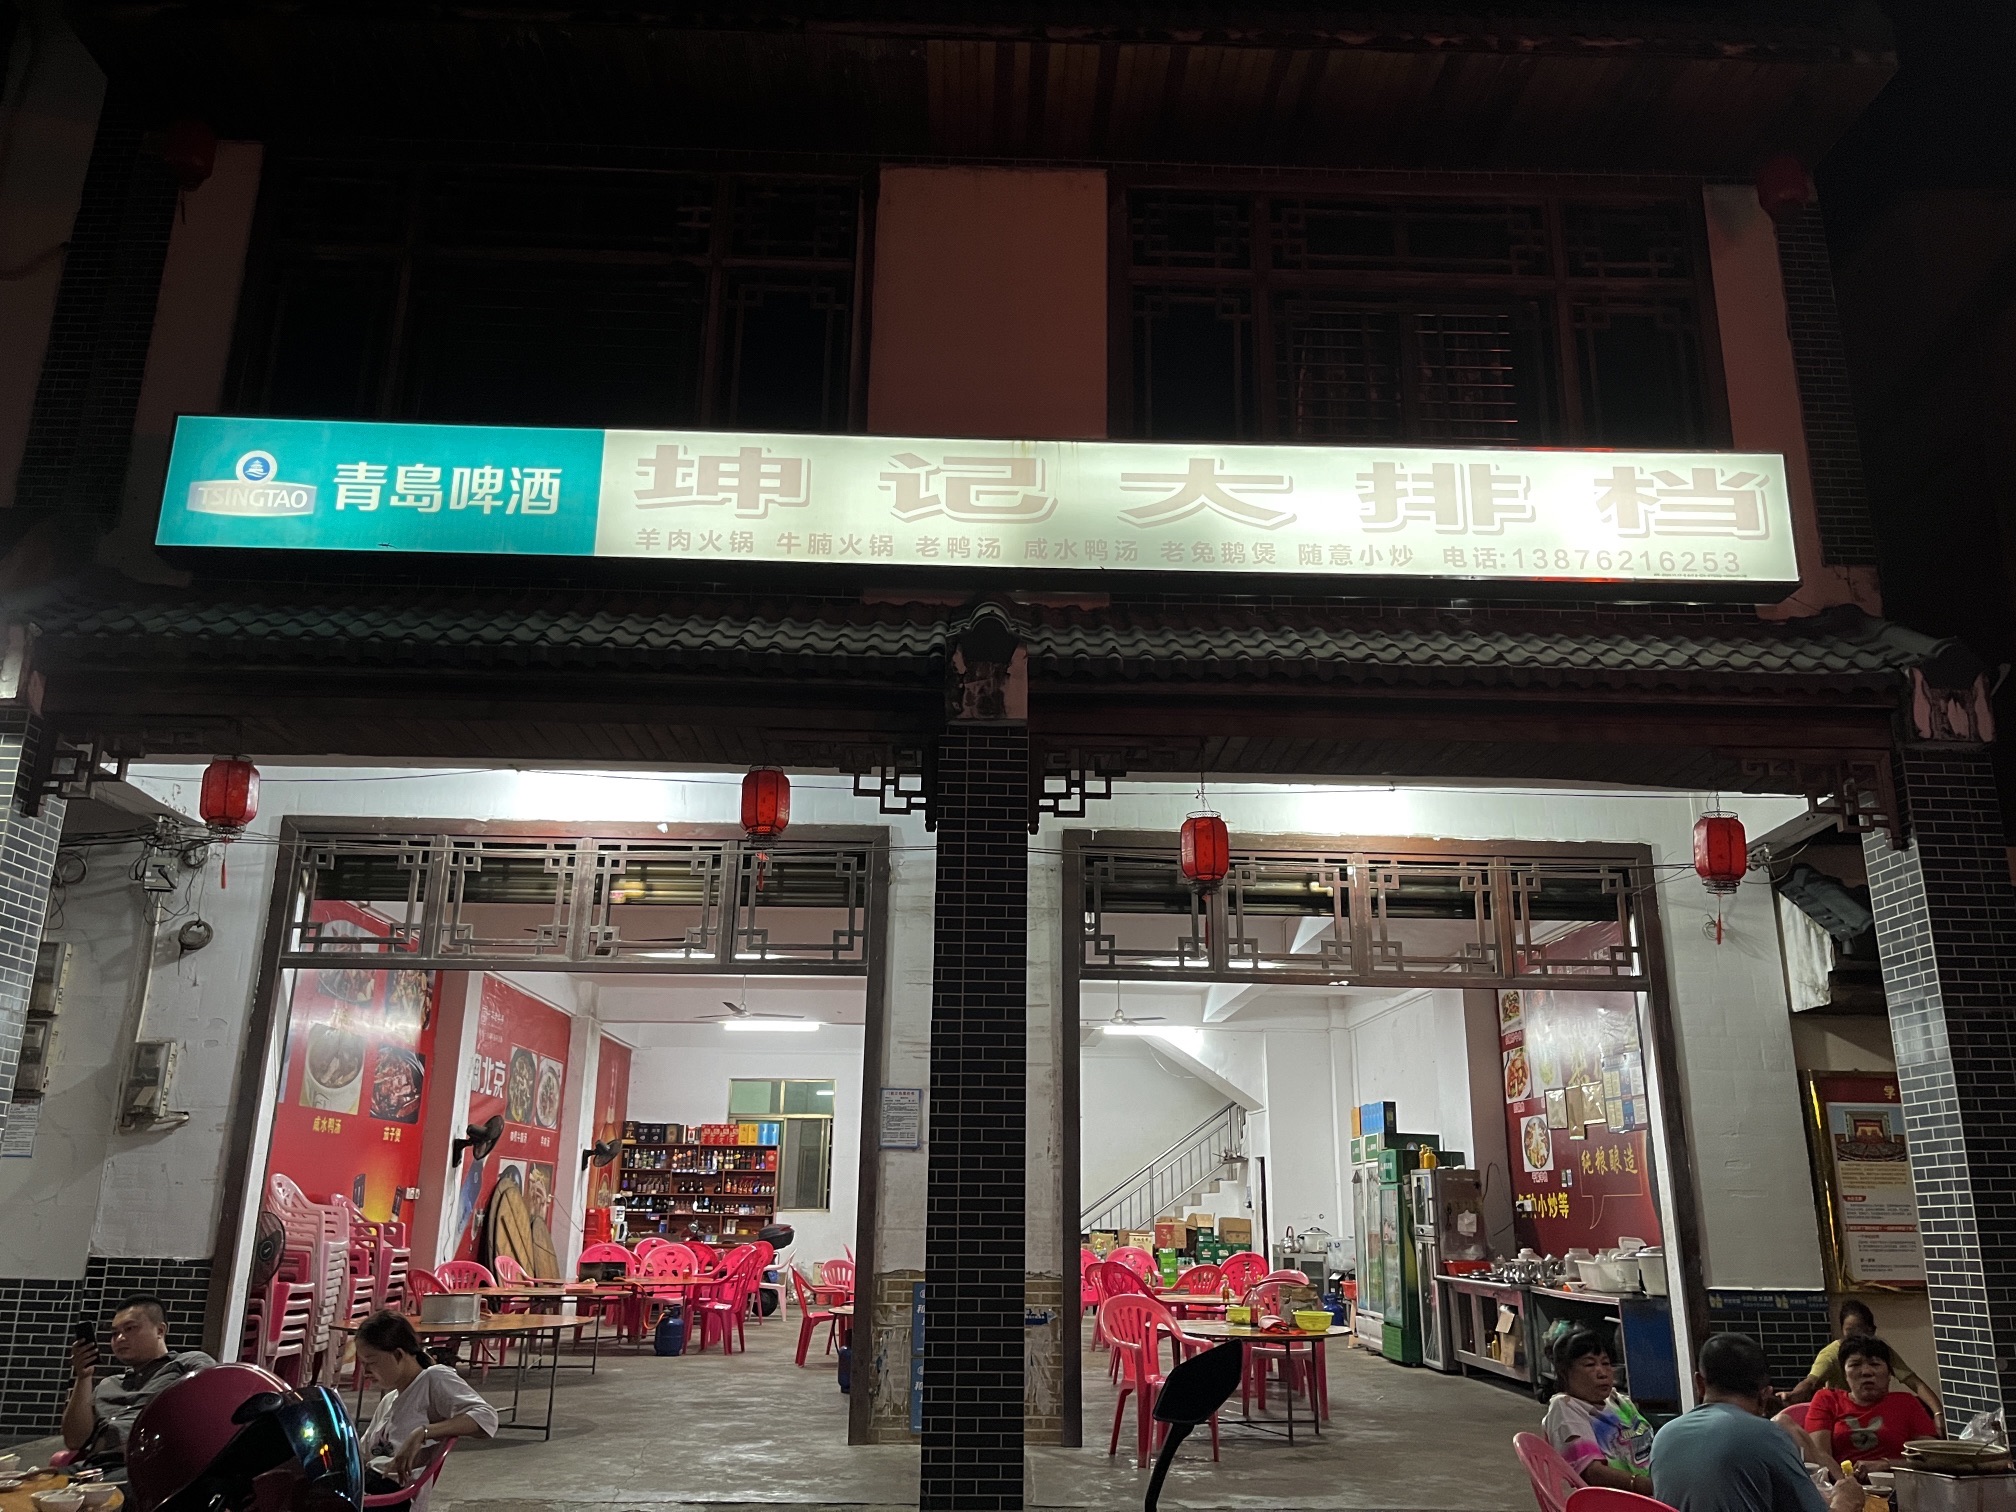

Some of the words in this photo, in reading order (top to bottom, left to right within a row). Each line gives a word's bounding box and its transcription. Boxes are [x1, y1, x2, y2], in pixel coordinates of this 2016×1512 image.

[198, 487, 308, 509] TSINGTAO
[635, 444, 1769, 540] 坤记大排档
[636, 528, 754, 555] 羊肉火锅
[777, 531, 894, 558] 牛腩火锅
[915, 535, 1002, 560] 老鸭汤
[1024, 538, 1139, 563] 咸水鸭汤
[1298, 543, 1414, 567] 随意小炒
